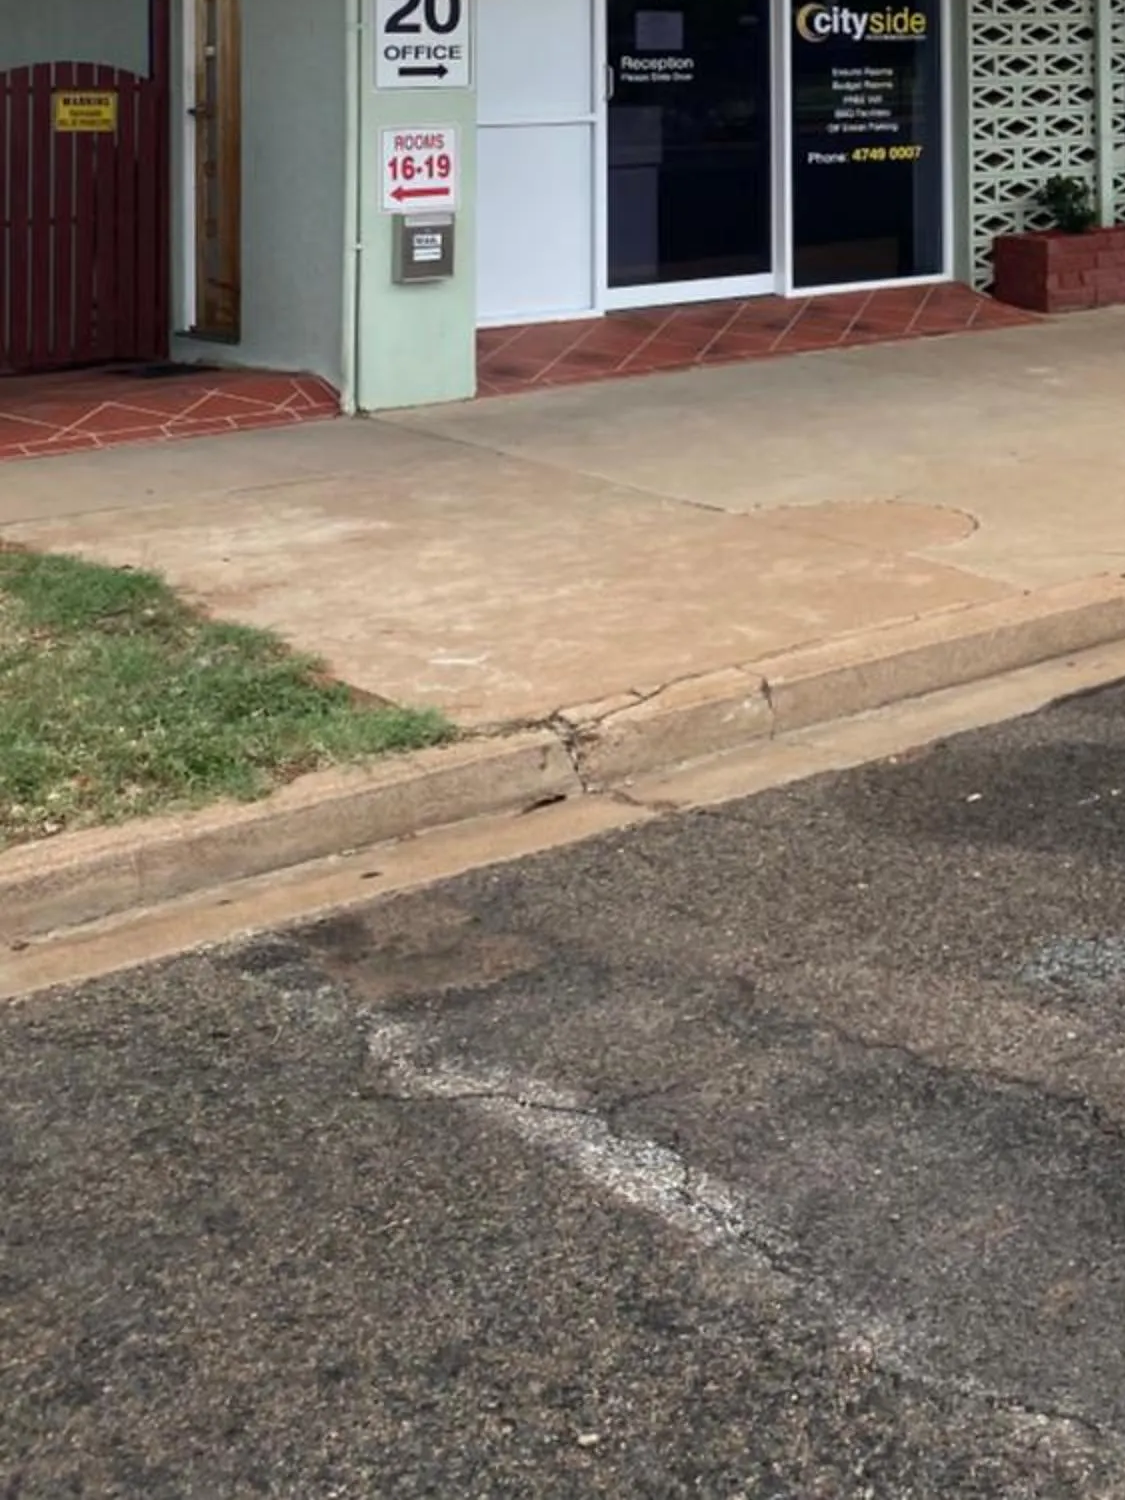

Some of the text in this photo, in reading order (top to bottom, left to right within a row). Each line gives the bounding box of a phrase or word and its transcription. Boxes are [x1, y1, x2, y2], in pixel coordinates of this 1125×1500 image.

[813, 5, 927, 40] cityside
[384, 45, 463, 61] OFFICE
[621, 55, 695, 72] Reception
[394, 133, 445, 151] ROOMS
